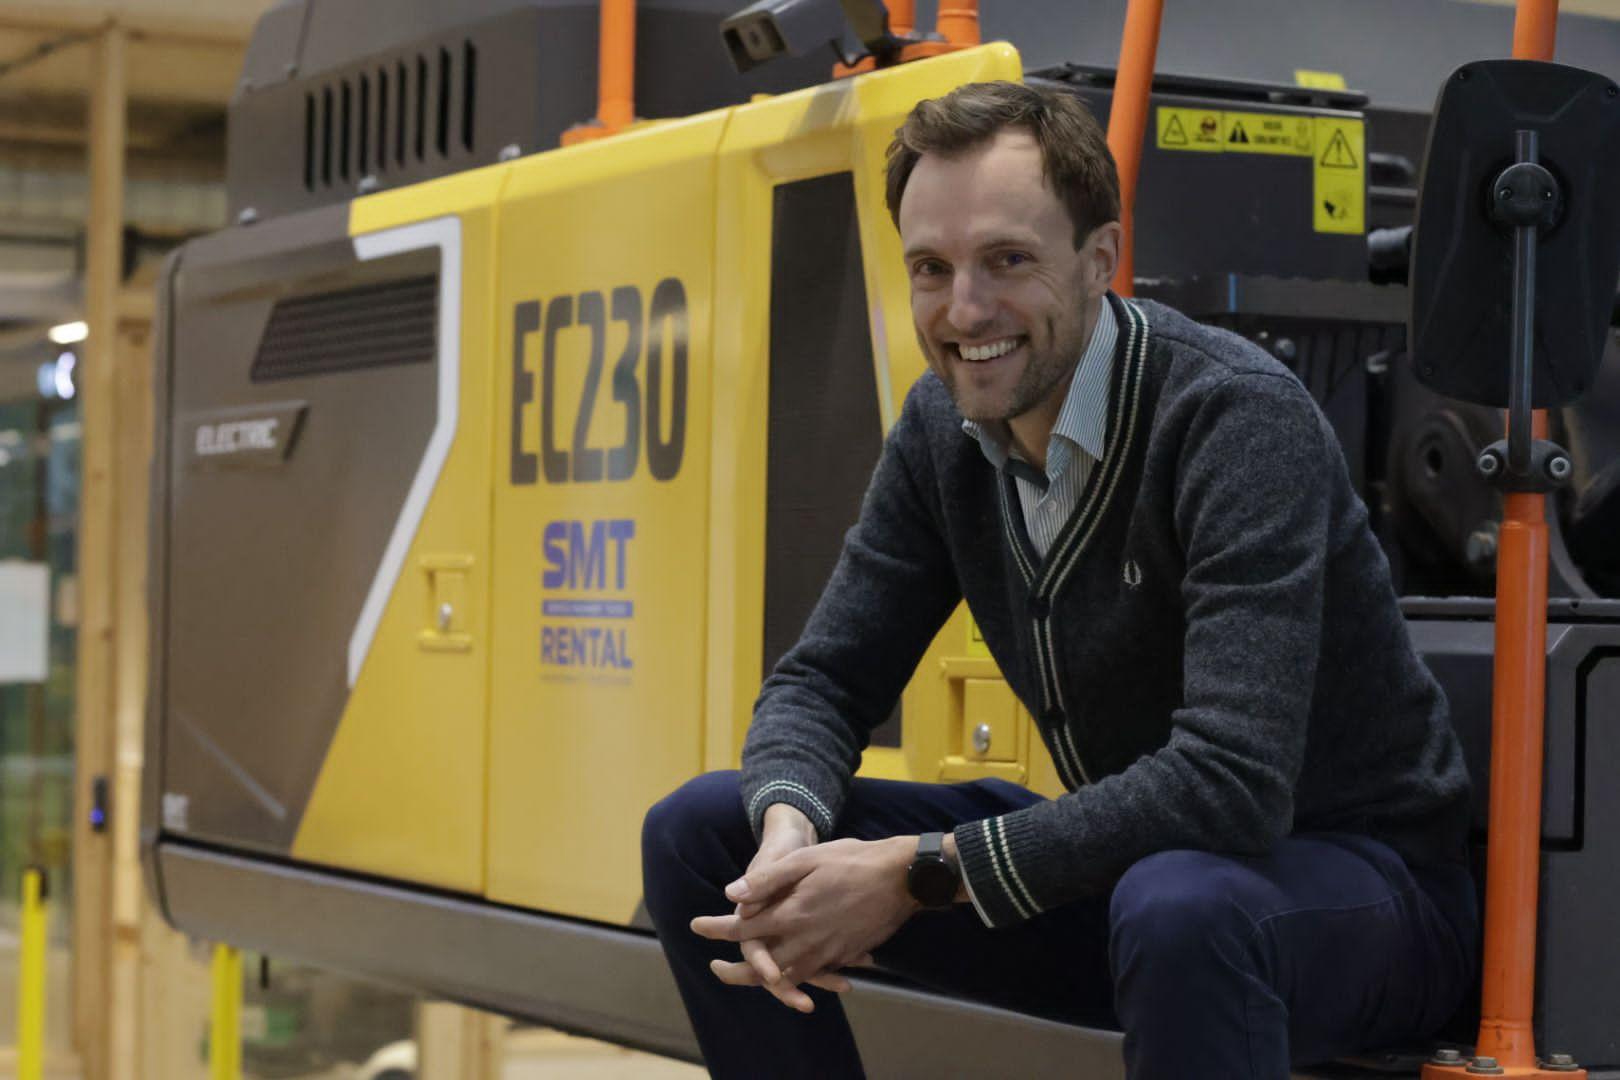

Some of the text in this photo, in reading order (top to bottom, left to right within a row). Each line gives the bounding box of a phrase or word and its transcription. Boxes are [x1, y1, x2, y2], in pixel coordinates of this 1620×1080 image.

[510, 277, 688, 485] EC230
[542, 520, 635, 590] SMT
[541, 626, 634, 669] RENTAL
